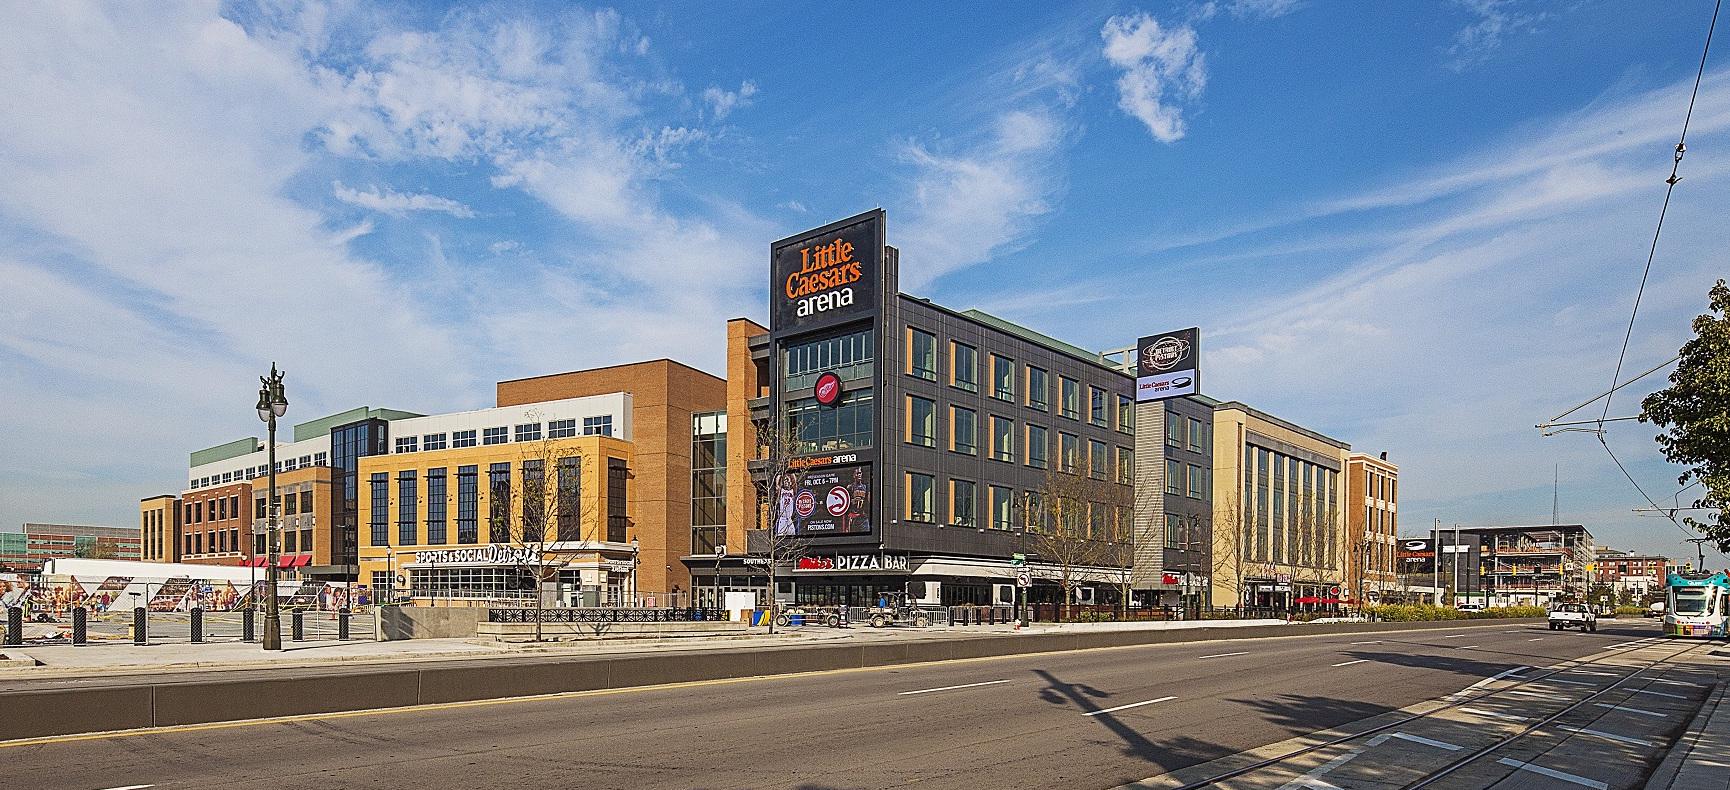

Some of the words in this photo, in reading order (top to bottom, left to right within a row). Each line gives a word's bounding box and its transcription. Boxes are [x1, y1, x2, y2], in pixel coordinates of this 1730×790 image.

[800, 238, 854, 275] Little
[786, 261, 862, 299] Caesars
[797, 287, 854, 317] arena
[789, 458, 806, 469] Little
[806, 456, 832, 467] Caesars
[832, 453, 857, 464] arena
[415, 550, 448, 564] SPORTS
[455, 548, 489, 563] SOCIAL
[837, 555, 880, 570] PIZZA
[884, 554, 907, 570] BAR
